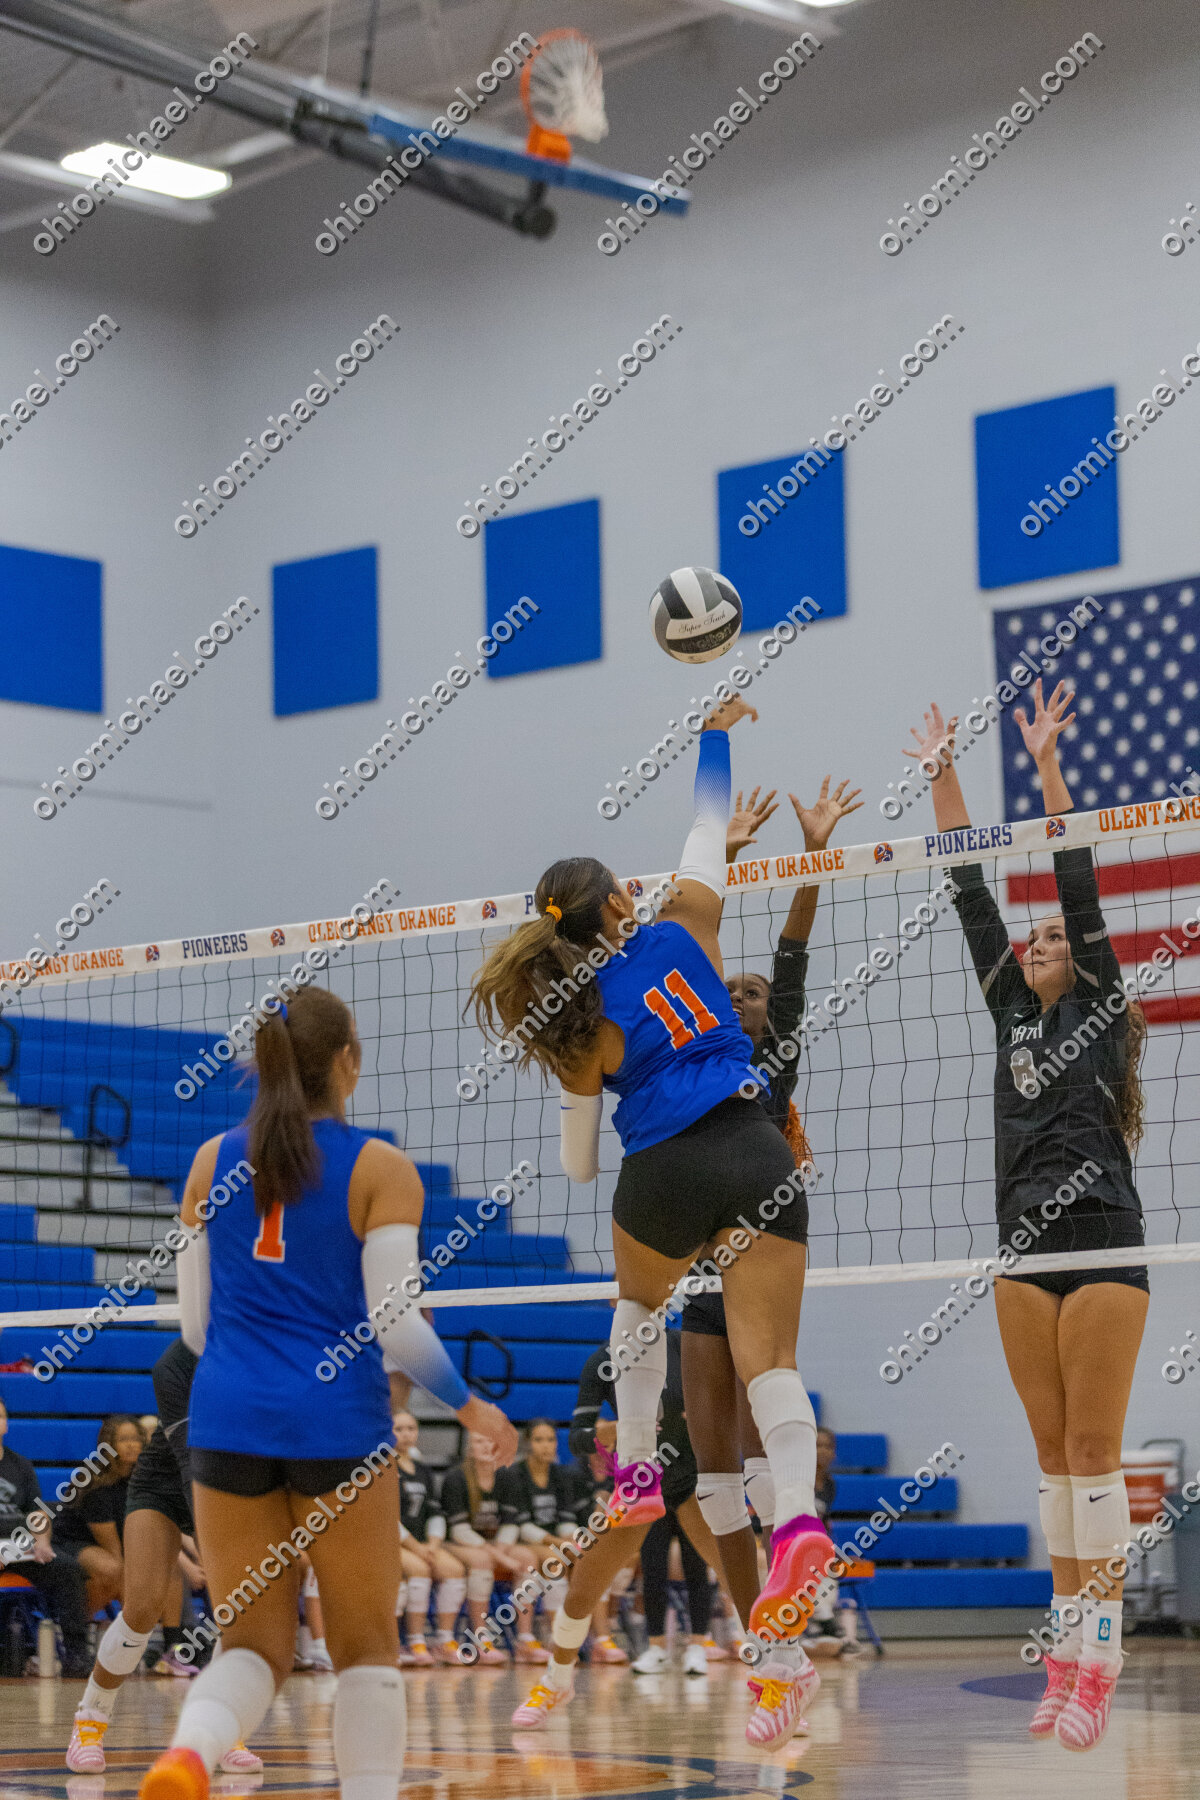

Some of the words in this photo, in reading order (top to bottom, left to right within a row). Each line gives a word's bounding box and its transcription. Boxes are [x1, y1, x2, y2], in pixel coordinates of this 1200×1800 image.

[924, 824, 1013, 857] PIONEERS
[776, 848, 845, 878] ORANGE
[398, 905, 456, 931] ORANGE
[73, 948, 124, 971] ORANGE
[182, 933, 248, 959] PIONEERS
[643, 967, 721, 1051] 11
